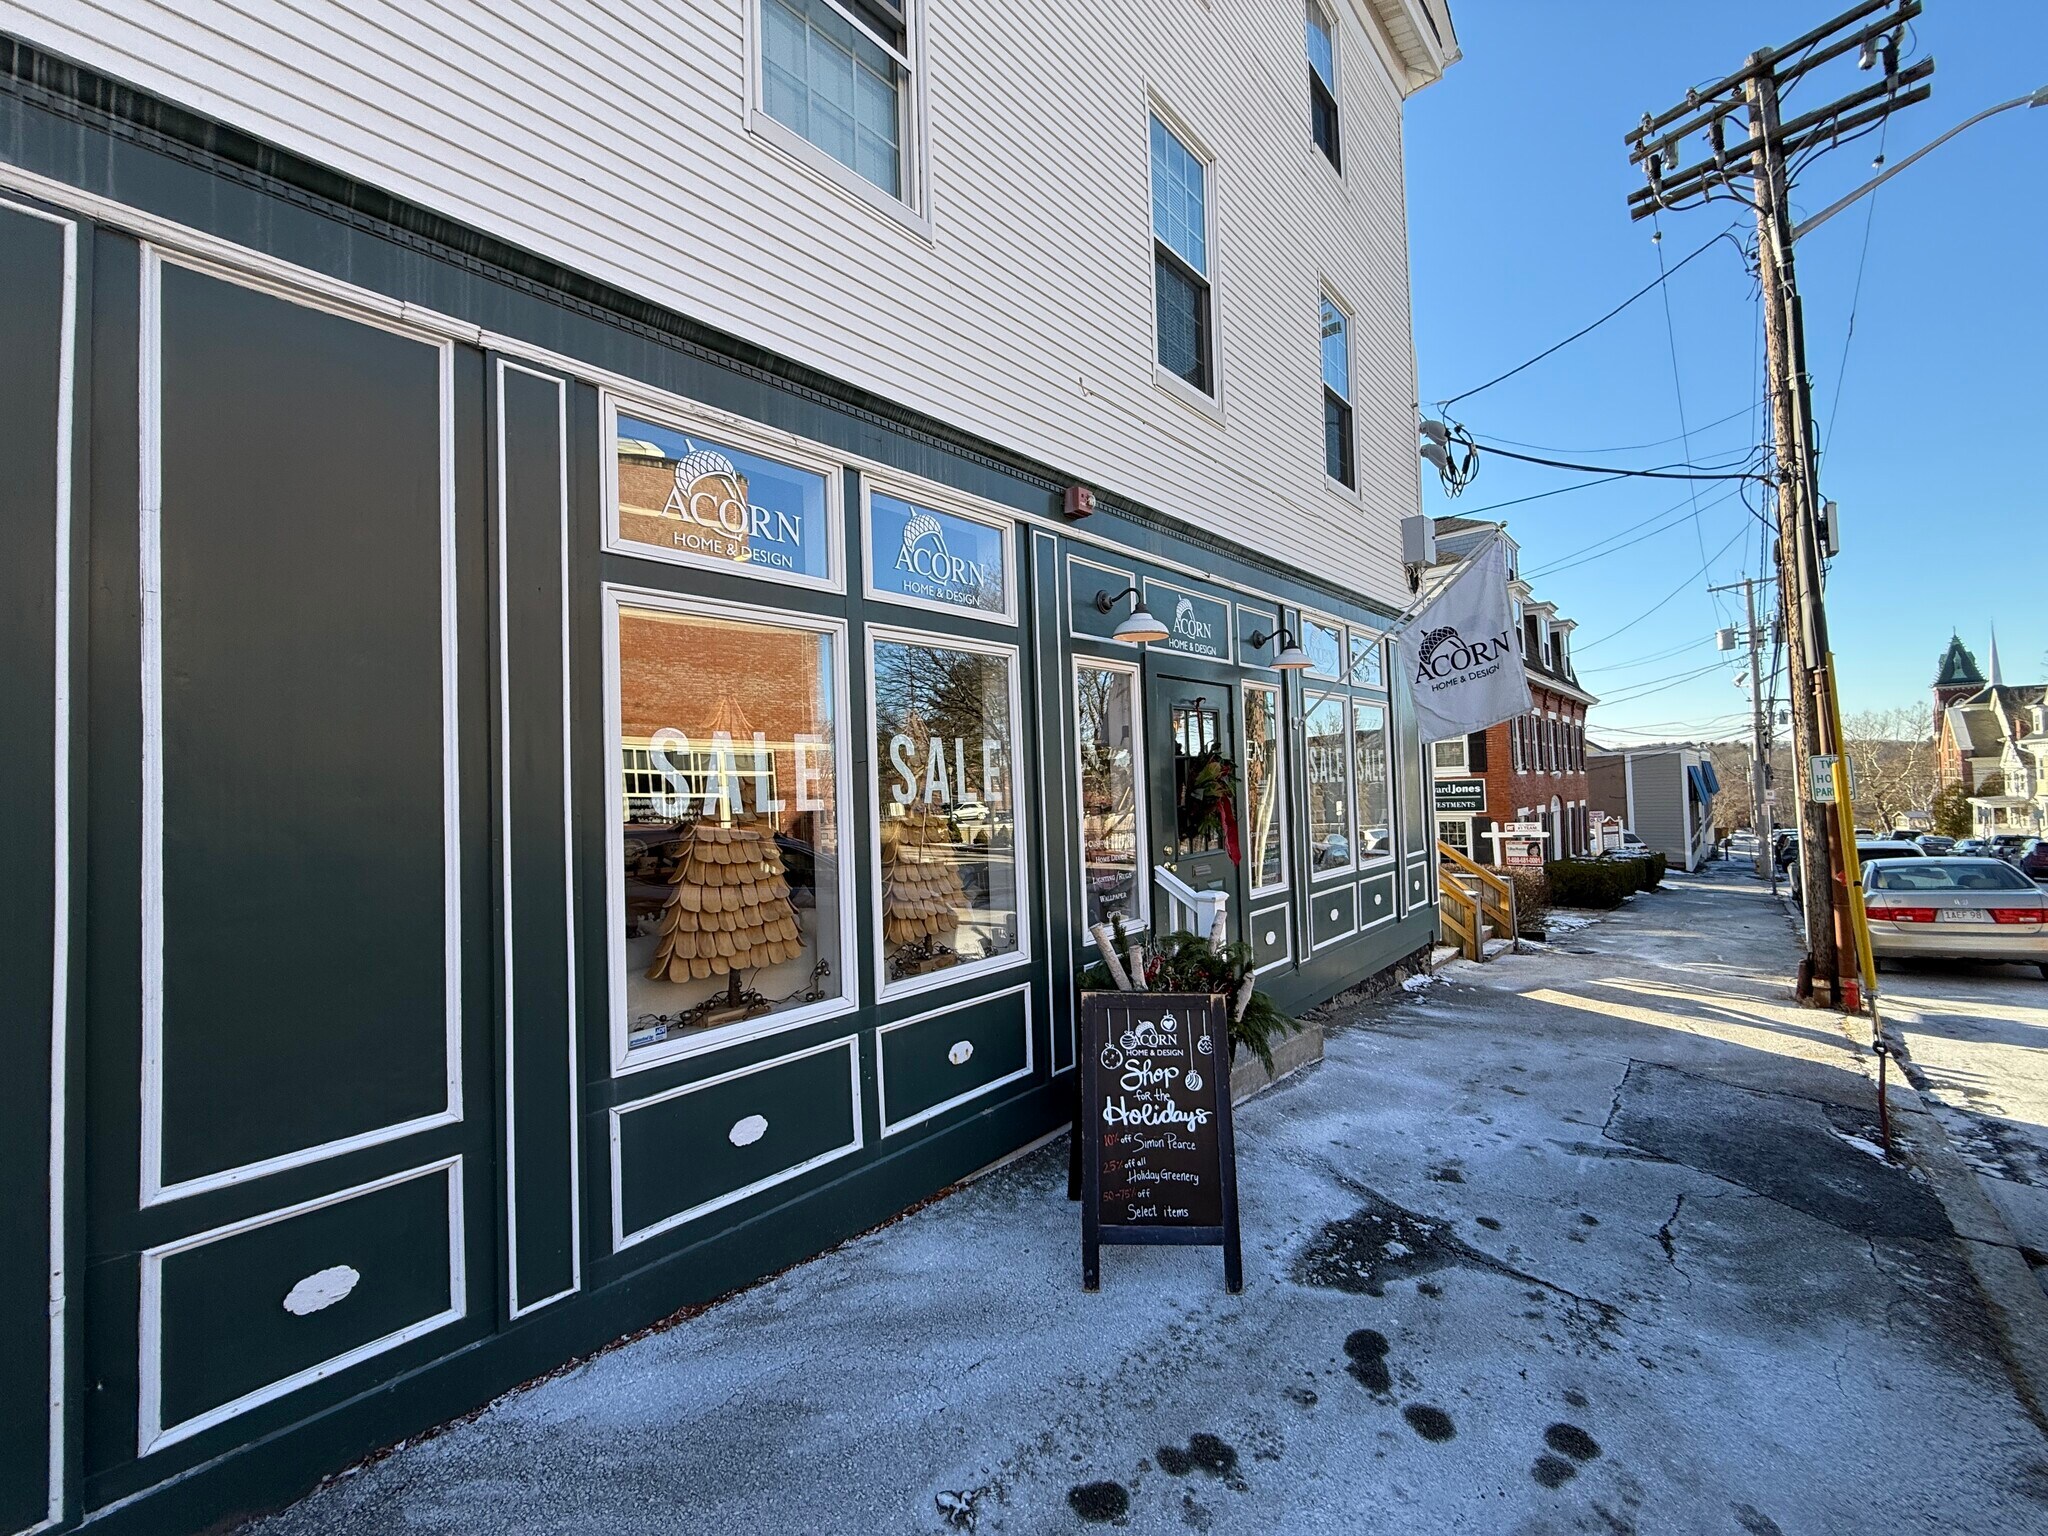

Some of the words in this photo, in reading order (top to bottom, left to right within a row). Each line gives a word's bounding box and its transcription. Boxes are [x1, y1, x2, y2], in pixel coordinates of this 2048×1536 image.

[660, 485, 802, 547] ACORN
[674, 532, 722, 554] HOME
[726, 544, 737, 557] &
[742, 546, 793, 569] DESIGN
[895, 544, 984, 588] ACORN
[904, 580, 935, 597] HOME
[936, 587, 944, 599] &
[946, 589, 980, 606] DESIGN
[1173, 617, 1212, 639] ACORN
[1168, 638, 1188, 651] HOME
[1189, 643, 1194, 652] &
[1195, 643, 1217, 656] DESIGN
[1415, 630, 1509, 684] ACORN
[1431, 677, 1458, 692] HOME
[1460, 673, 1467, 683] &
[1468, 663, 1500, 680] DESIGN
[1247, 740, 1264, 762] EN
[650, 727, 824, 818] SALE
[890, 734, 1003, 805] SALE
[1309, 747, 1345, 784] SALE
[1356, 749, 1386, 783] SALE
[1452, 784, 1481, 794] Jones
[1133, 1034, 1177, 1046] ACORN
[1120, 1059, 1179, 1091] Shop
[1154, 1088, 1171, 1101] the
[1103, 1096, 1213, 1132] Holidays
[1103, 1132, 1119, 1147] 10%
[1120, 1134, 1132, 1144] off
[1133, 1132, 1164, 1152] Simon
[1164, 1132, 1196, 1150] Pearce
[1103, 1160, 1124, 1173] 25%
[1124, 1158, 1136, 1169] off
[1137, 1157, 1146, 1166] all
[1127, 1169, 1160, 1184] Holiday
[1160, 1168, 1199, 1186] Greenery
[1138, 1188, 1150, 1198] off
[1127, 1203, 1157, 1220] Select
[1163, 1205, 1189, 1217] items
